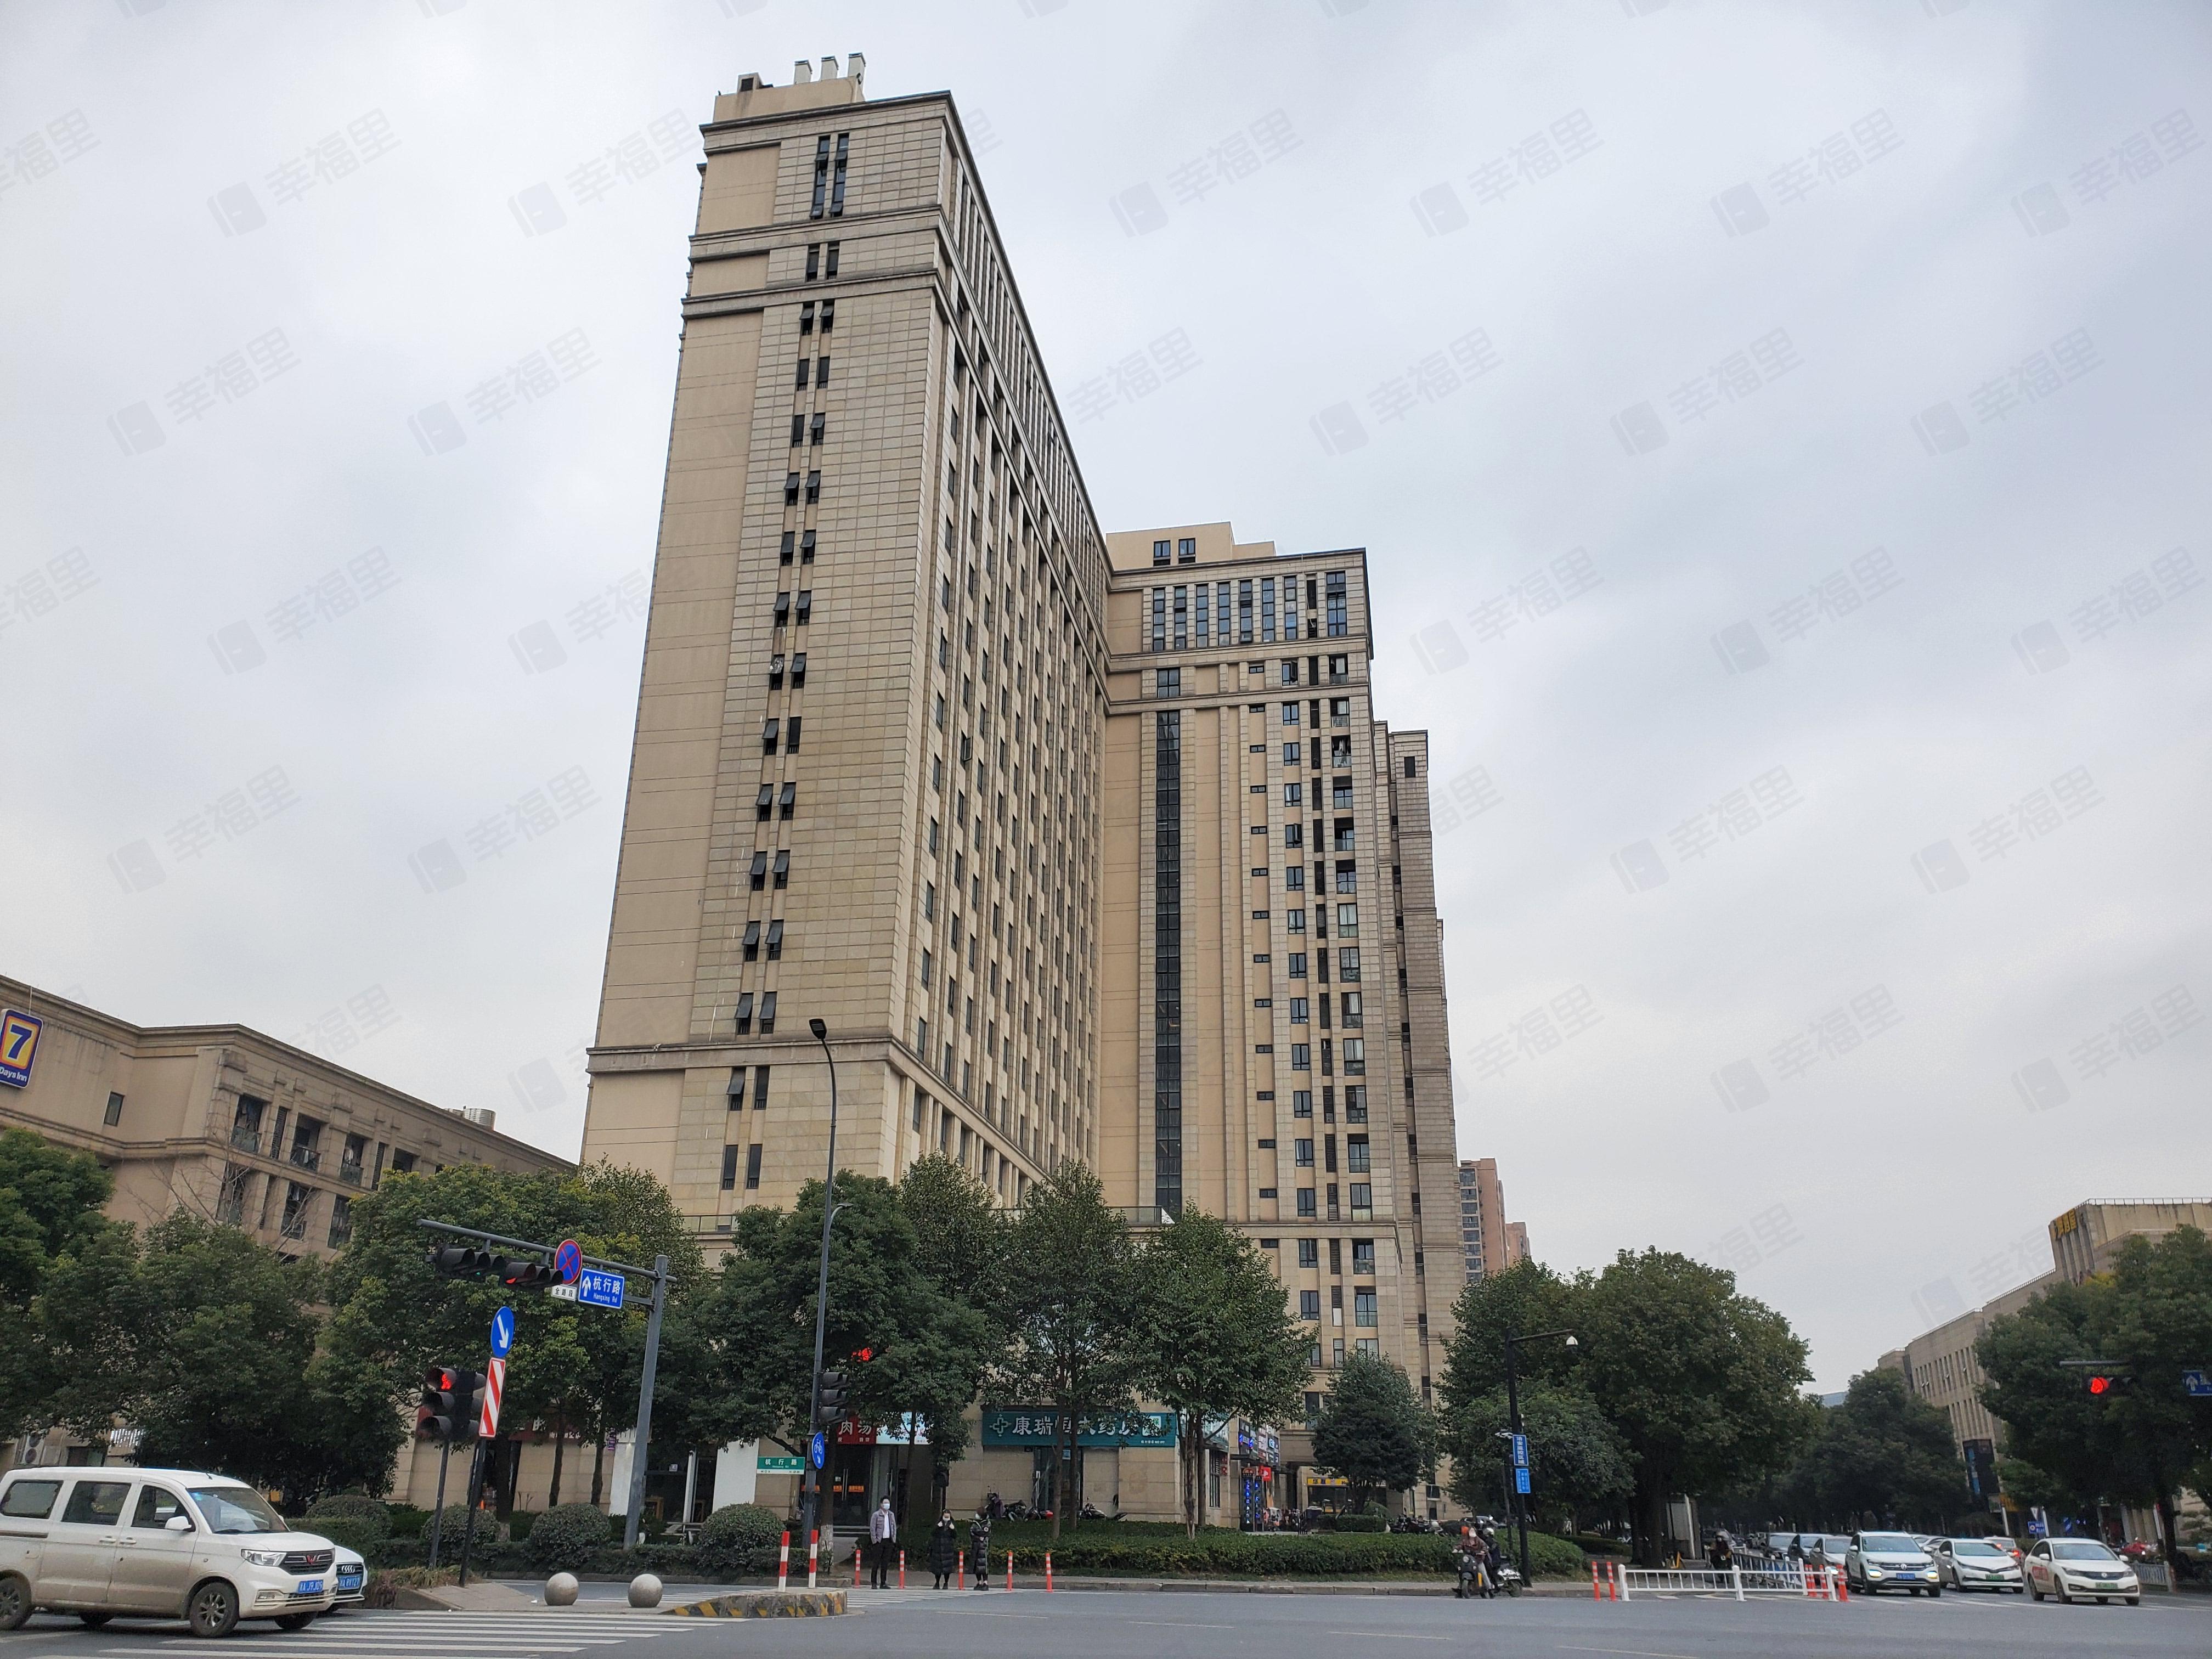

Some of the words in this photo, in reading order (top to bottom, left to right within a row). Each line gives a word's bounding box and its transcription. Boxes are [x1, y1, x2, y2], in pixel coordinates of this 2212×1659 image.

[8, 1024, 33, 1060] 7
[0, 1066, 16, 1079] Days
[17, 1071, 27, 1082] Inn
[555, 1287, 573, 1297] 全路段
[593, 1276, 621, 1295] 杭行路
[593, 1292, 610, 1303] Hangxing
